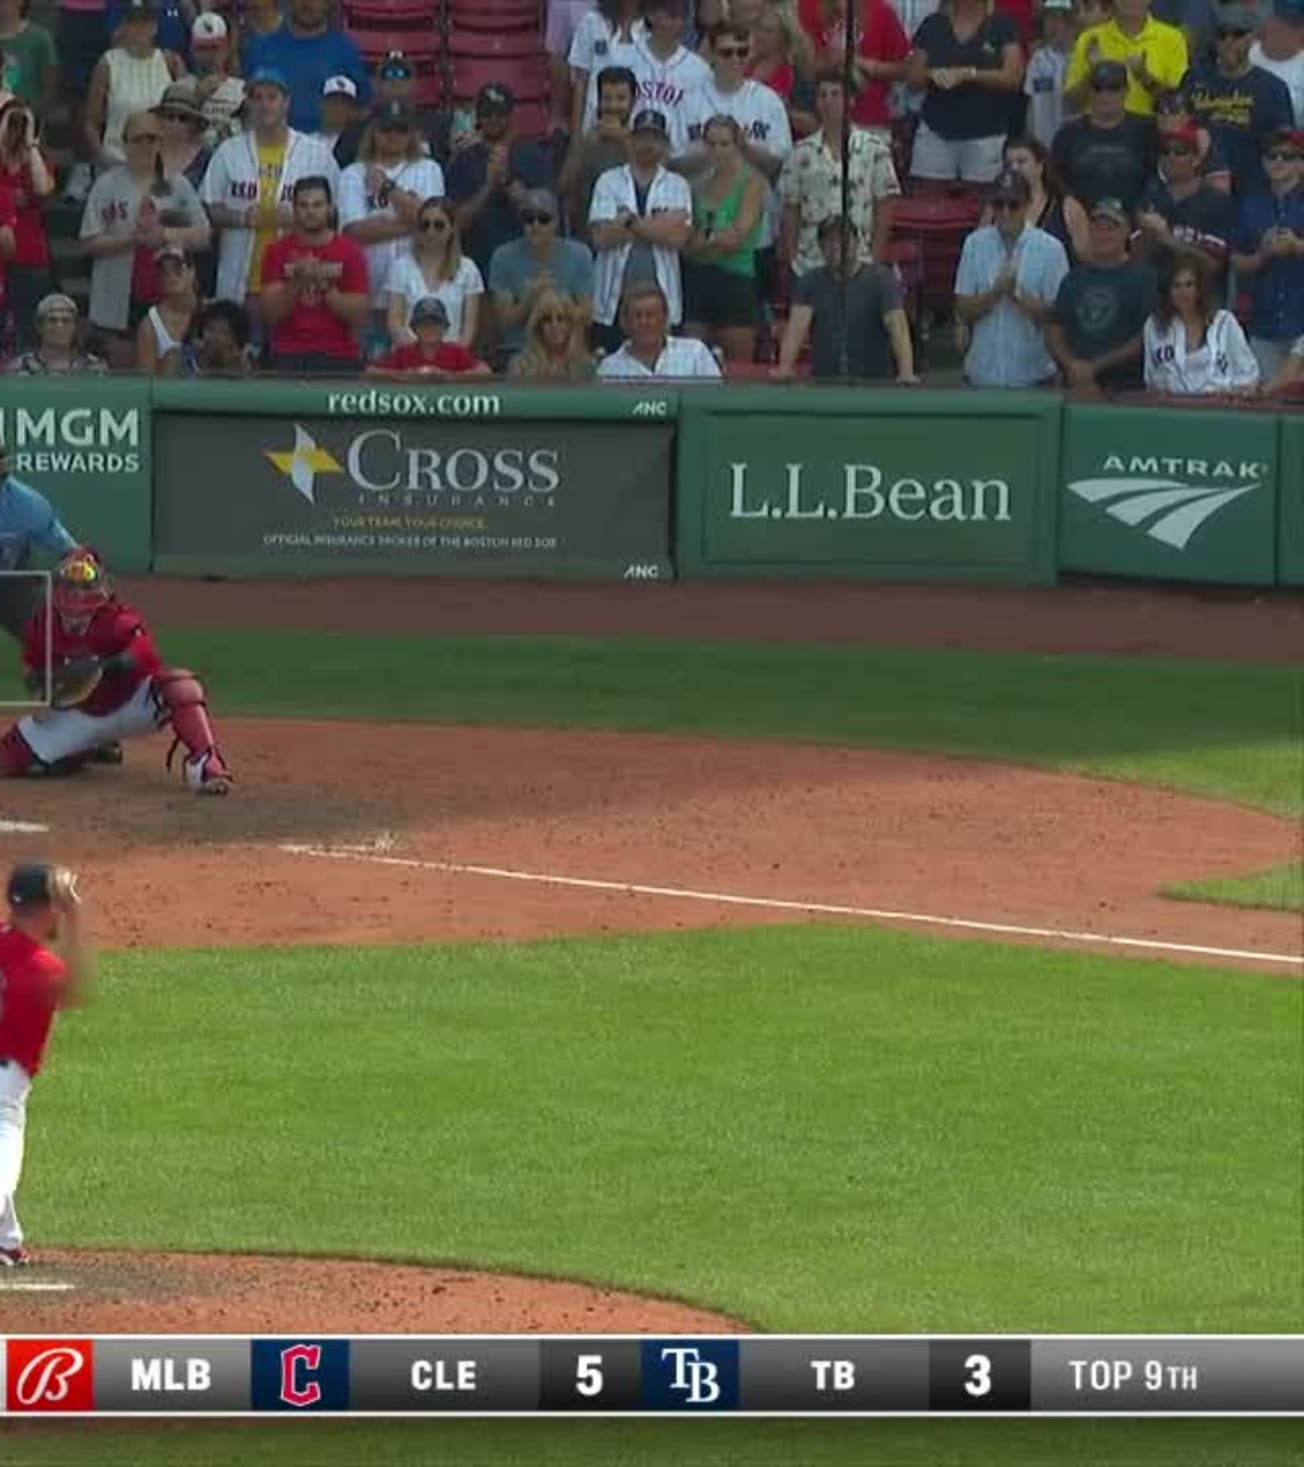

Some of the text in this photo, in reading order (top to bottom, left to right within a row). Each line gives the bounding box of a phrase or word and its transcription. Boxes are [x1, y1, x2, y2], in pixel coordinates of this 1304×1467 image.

[328, 389, 500, 415] redsox.com
[632, 400, 667, 416] ANC
[16, 408, 139, 446] MGM
[16, 452, 140, 472] REWARDS
[1103, 456, 1260, 478] AMTRAK
[359, 493, 556, 507] INSURANCE
[730, 462, 1011, 521] L.L.Bean
[623, 564, 658, 579] ANC
